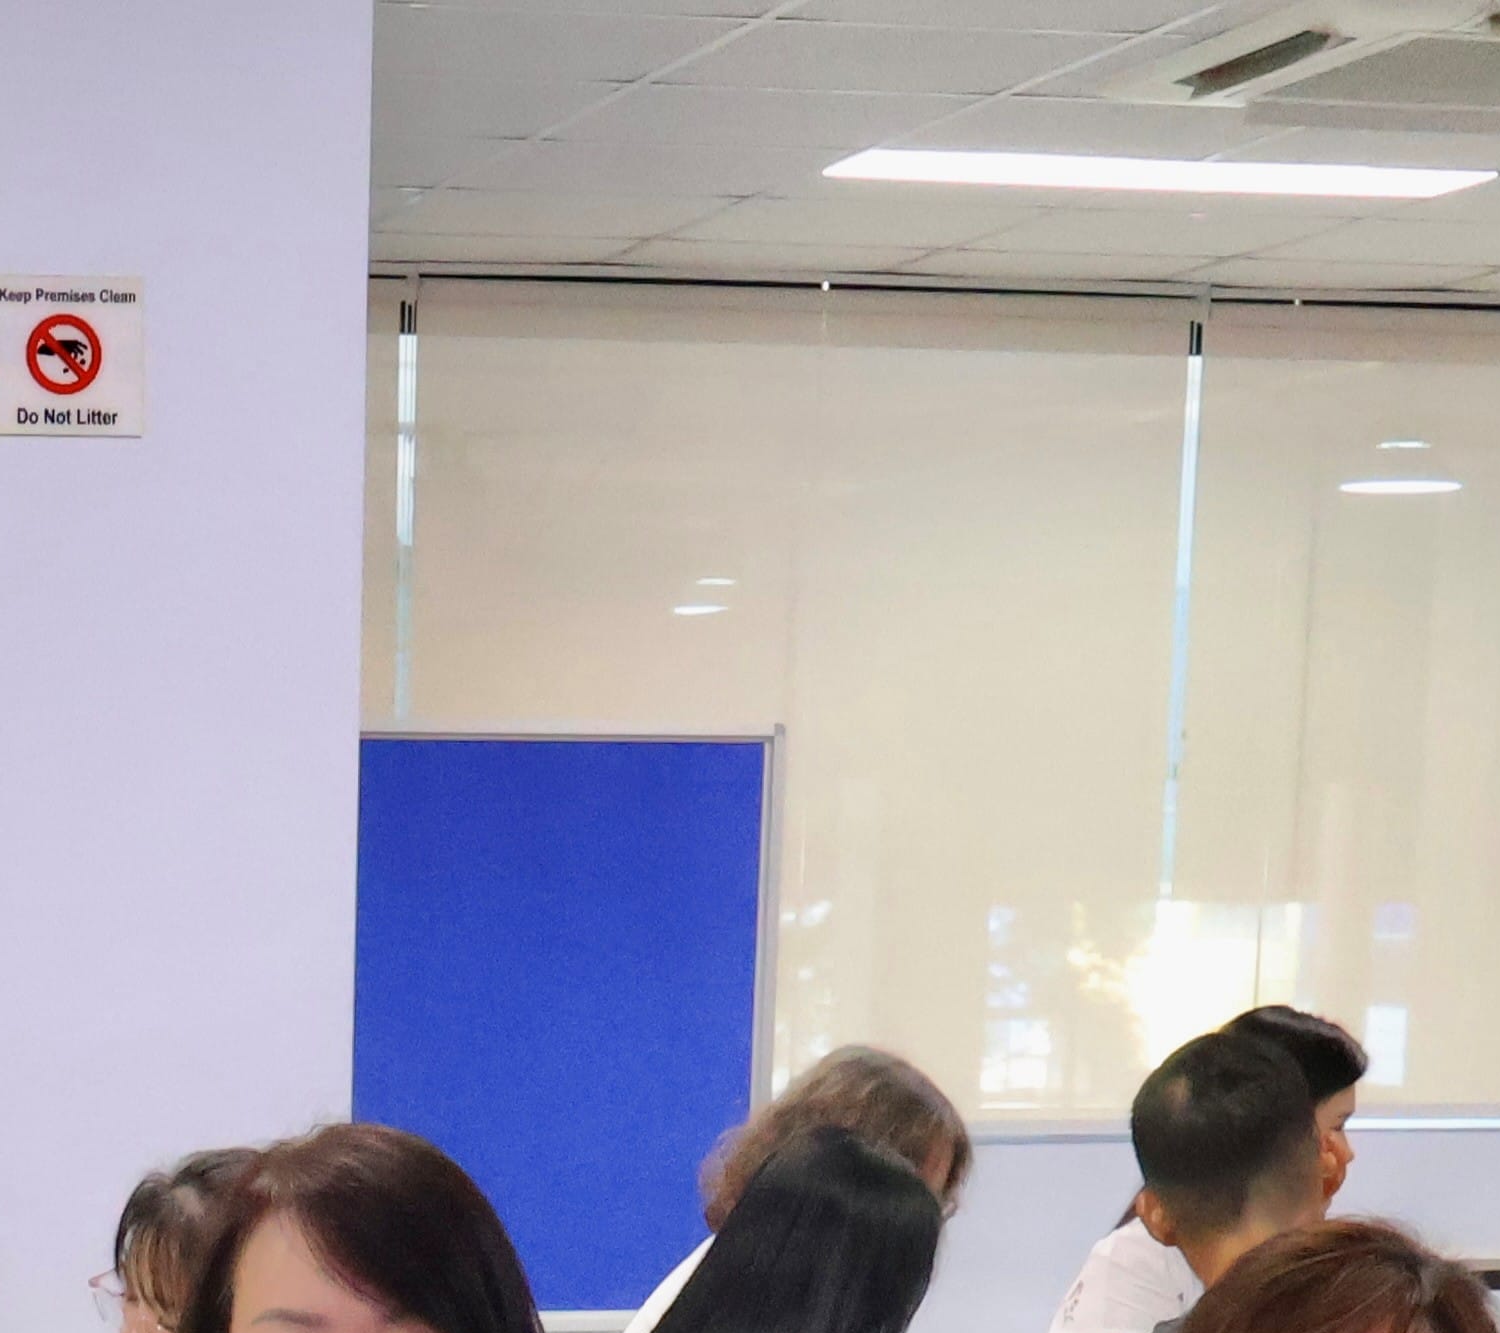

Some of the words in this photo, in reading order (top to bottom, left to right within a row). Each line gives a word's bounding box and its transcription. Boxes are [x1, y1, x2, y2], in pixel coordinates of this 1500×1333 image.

[35, 288, 96, 303] Premises
[99, 289, 136, 304] Clean
[17, 408, 38, 424] Do
[44, 408, 71, 425] Not
[77, 408, 118, 425] Litter
